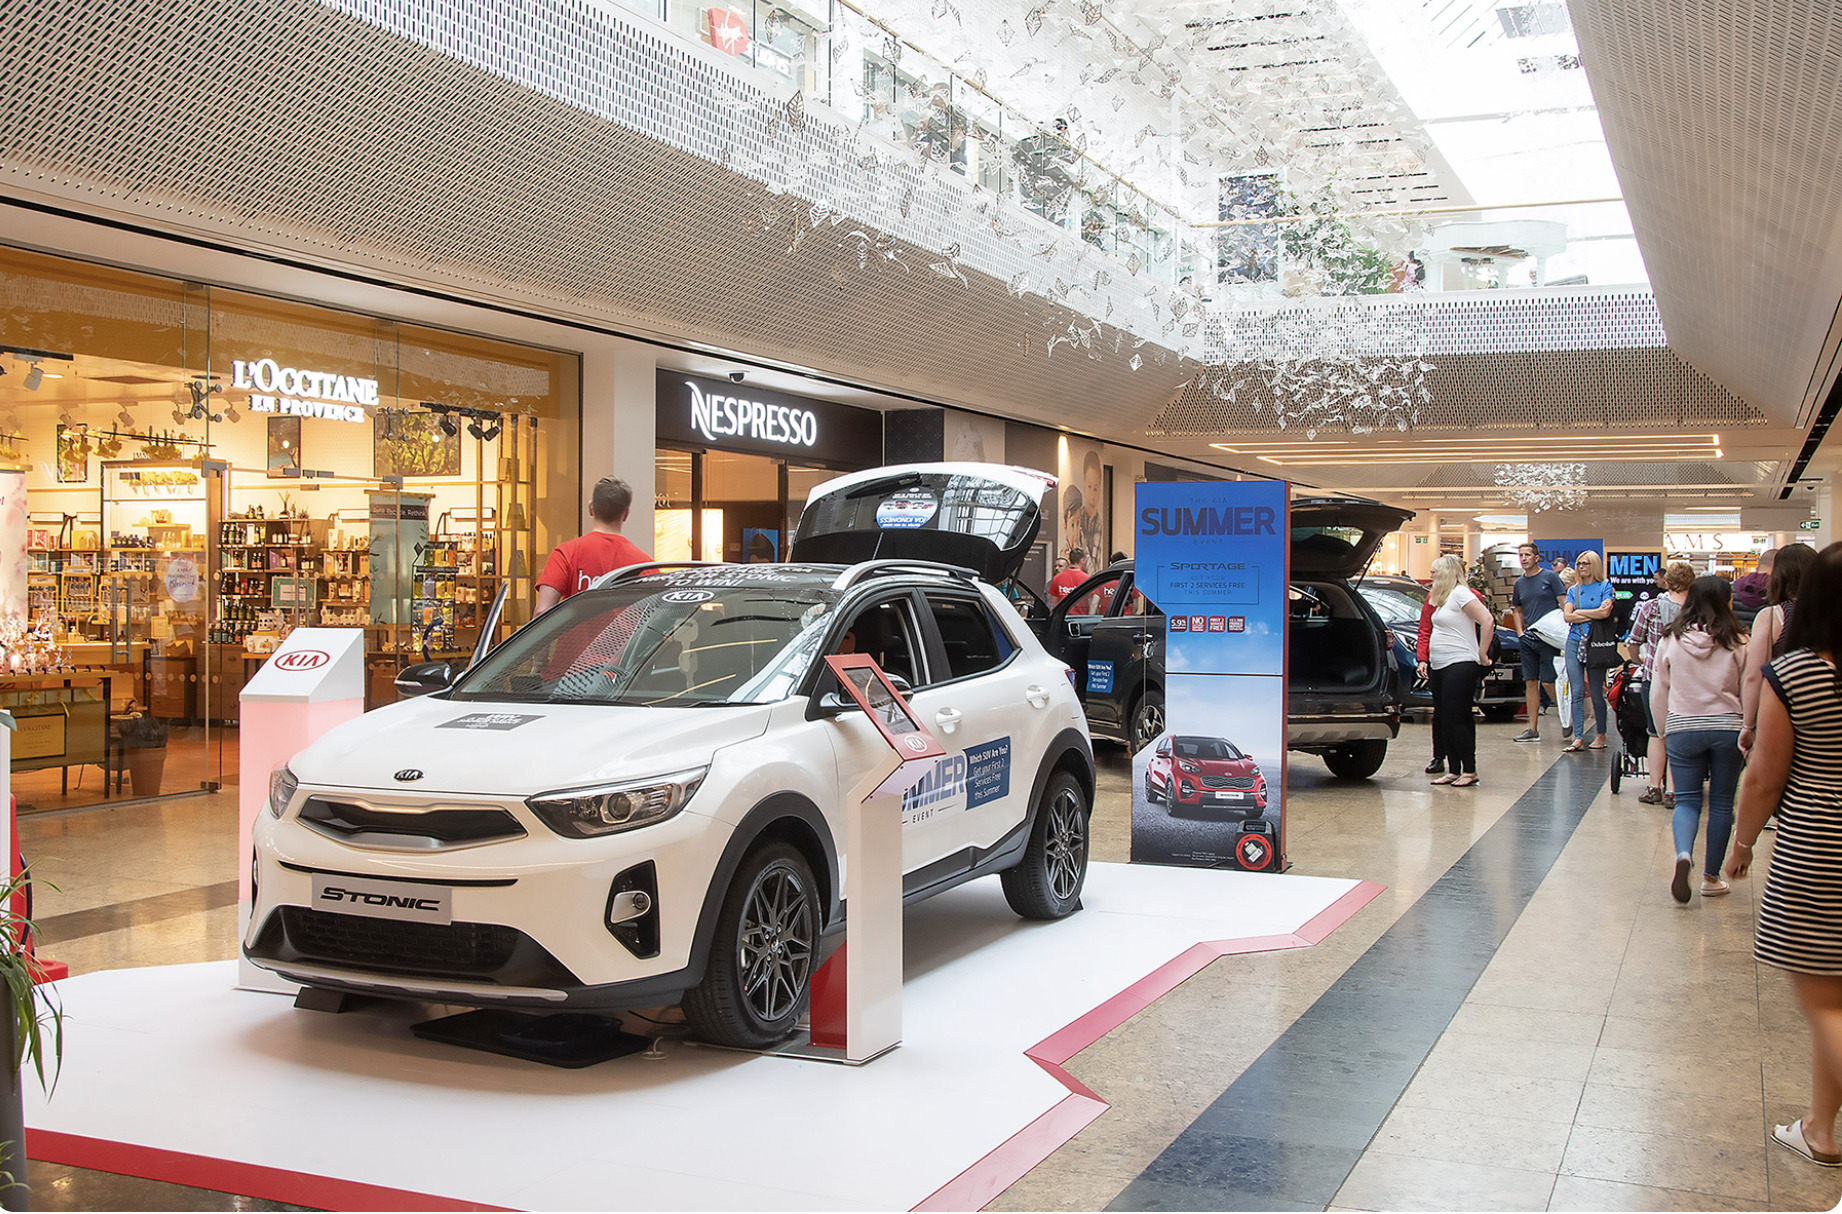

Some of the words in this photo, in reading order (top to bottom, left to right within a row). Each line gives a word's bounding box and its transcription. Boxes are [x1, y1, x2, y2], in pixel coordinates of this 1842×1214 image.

[232, 358, 379, 405] L'OCCITANE
[249, 394, 276, 412] EN
[277, 398, 364, 422] PROVENCE
[685, 381, 817, 446] NESPRESSO
[1141, 506, 1276, 536] SUMMER
[1170, 562, 1246, 571] SPORTAGE
[1609, 555, 1659, 576] MEN
[1610, 576, 1621, 584] We
[1632, 576, 1646, 584] with
[669, 591, 704, 601] KIA
[1192, 616, 1204, 625] NO
[282, 654, 320, 667] KIA
[396, 770, 419, 779] KIA
[974, 775, 992, 788] Services
[983, 785, 1001, 798] Summer
[912, 809, 934, 824] EVENT
[320, 887, 441, 911] STONIC
